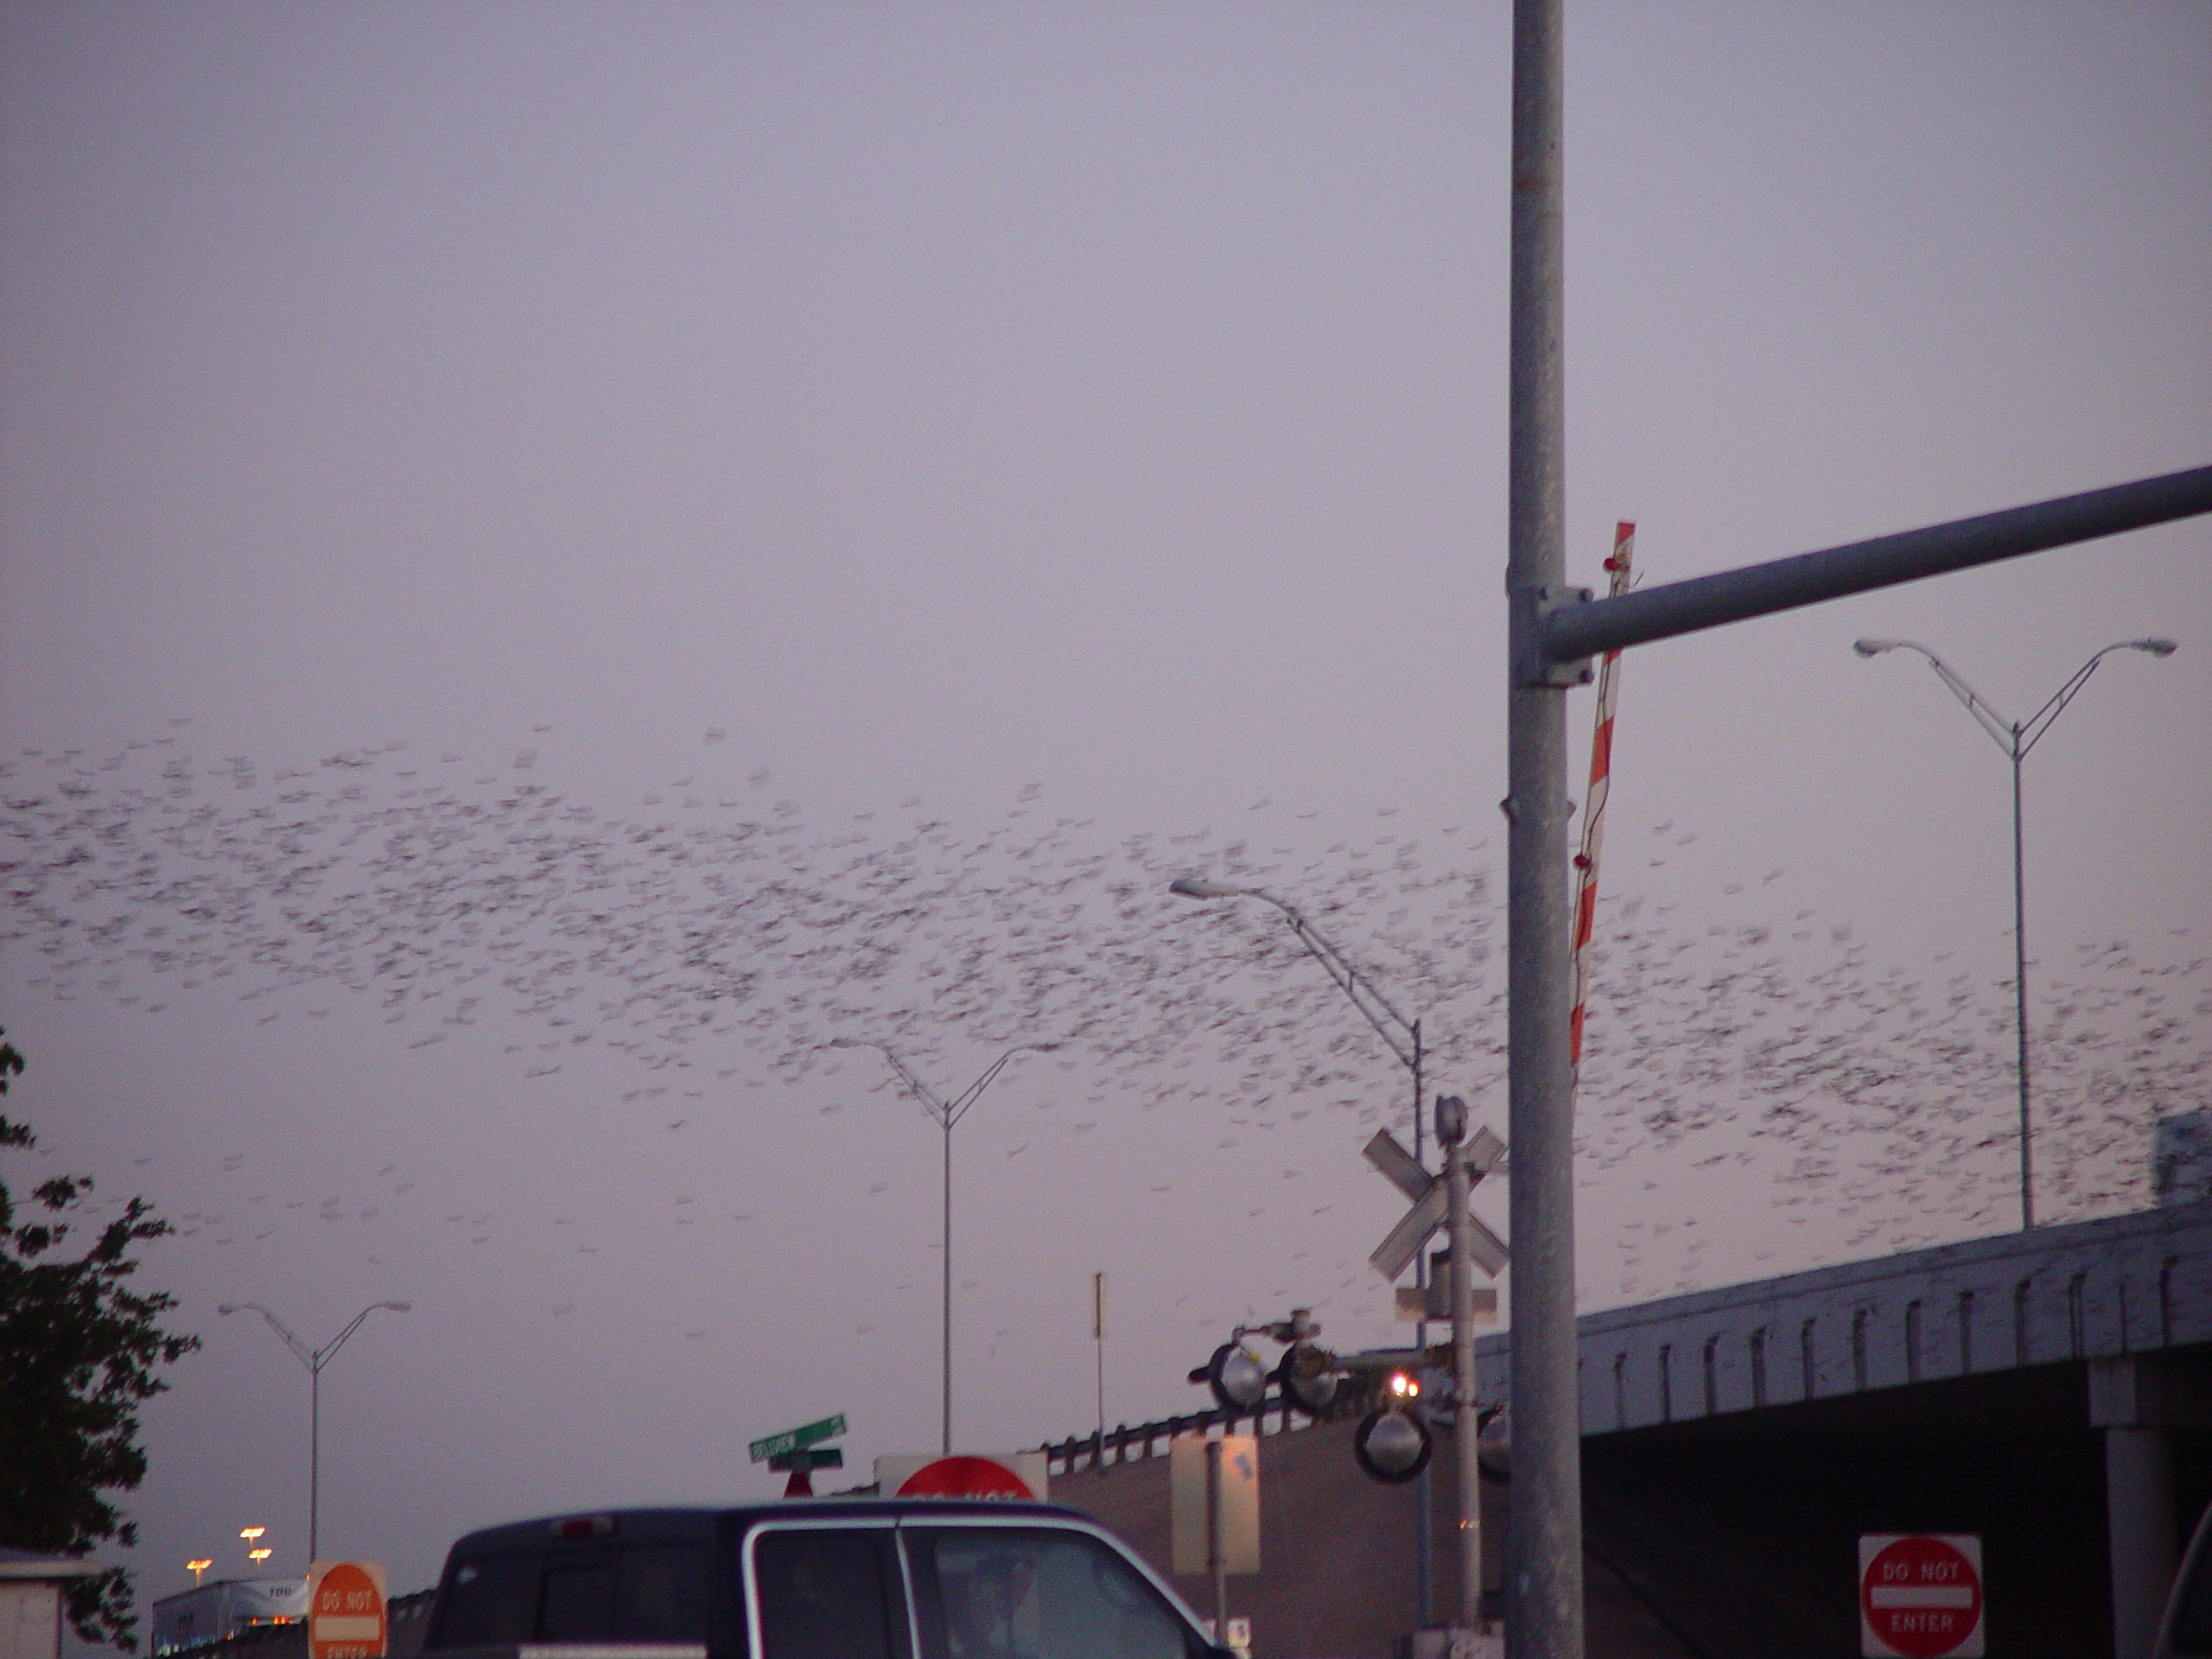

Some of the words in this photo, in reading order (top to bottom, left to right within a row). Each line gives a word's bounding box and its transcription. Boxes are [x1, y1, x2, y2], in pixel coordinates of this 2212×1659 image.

[1883, 1562, 1908, 1580] DO
[1921, 1562, 1959, 1580] NOT
[322, 1591, 340, 1611] DO
[346, 1590, 372, 1611] NOT
[1891, 1613, 1954, 1632] ENTER
